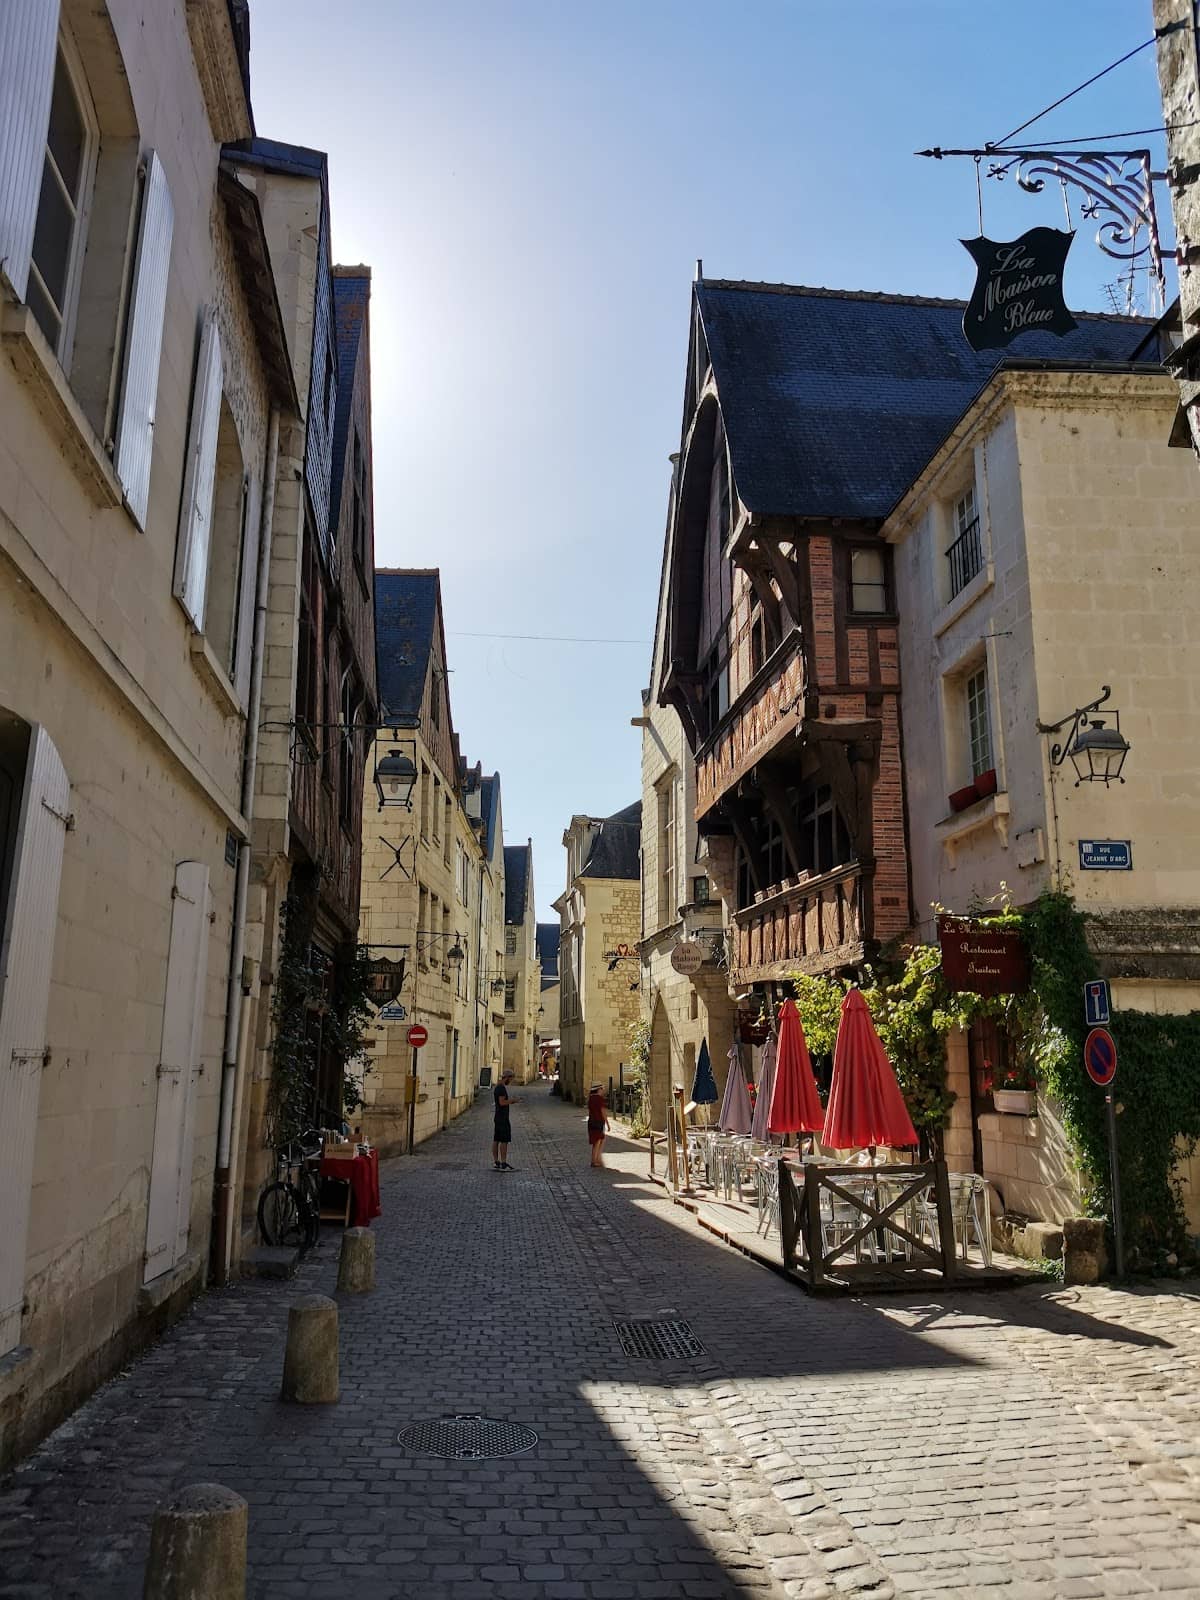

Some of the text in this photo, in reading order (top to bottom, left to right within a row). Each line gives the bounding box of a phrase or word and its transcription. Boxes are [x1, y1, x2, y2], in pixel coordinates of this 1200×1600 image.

[990, 245, 1036, 275] La
[977, 273, 1057, 322] Maison
[1003, 299, 1054, 333] Bleue
[943, 921, 956, 934] La
[959, 942, 1006, 955] Restaurant
[967, 961, 1001, 975] Traiteur
